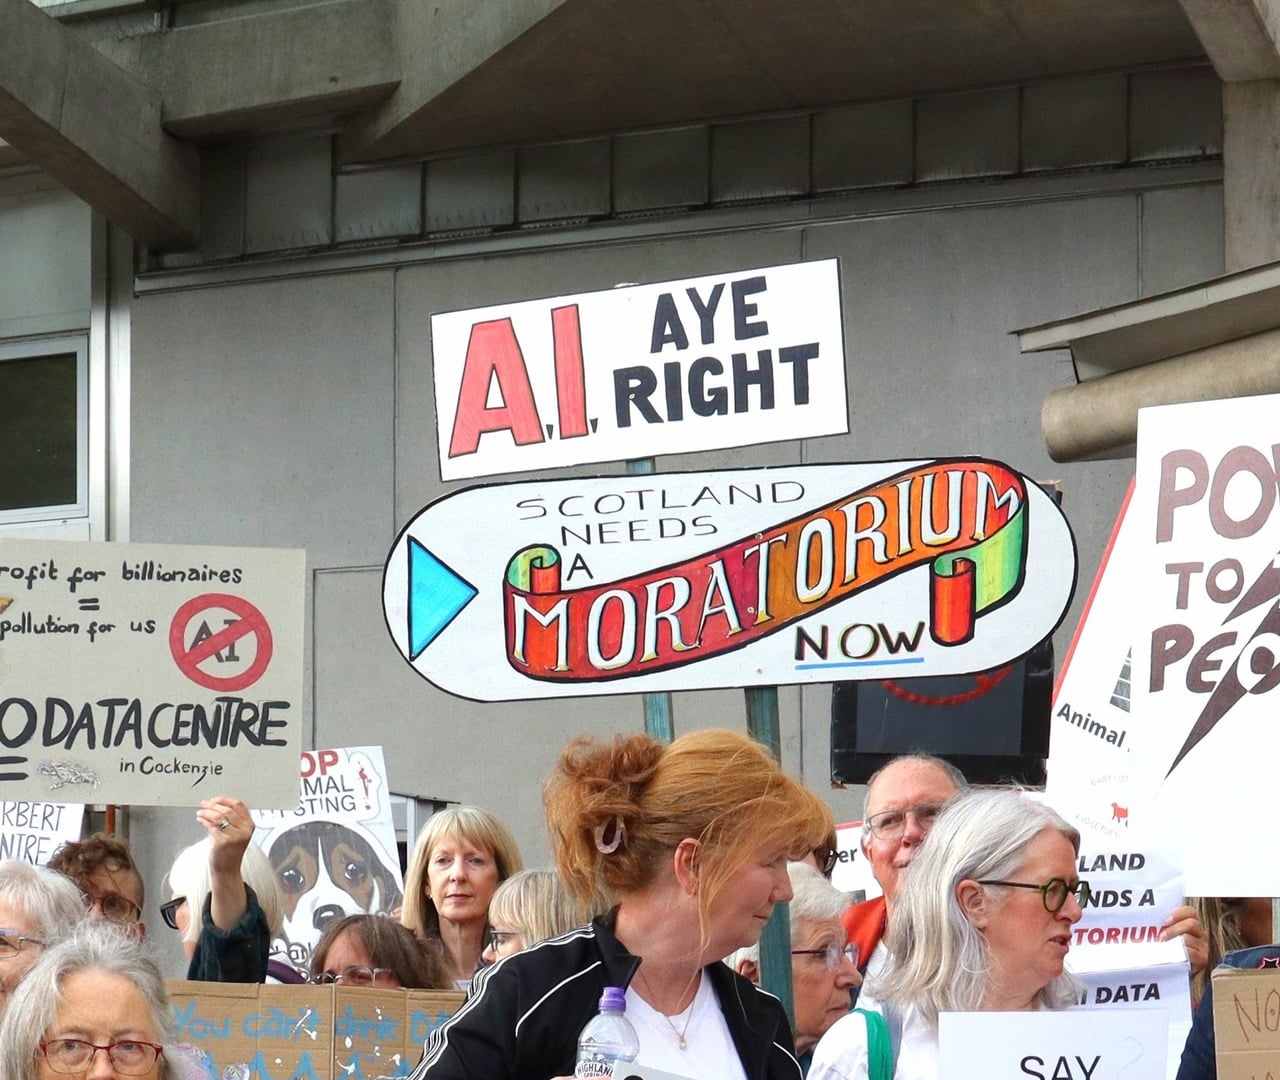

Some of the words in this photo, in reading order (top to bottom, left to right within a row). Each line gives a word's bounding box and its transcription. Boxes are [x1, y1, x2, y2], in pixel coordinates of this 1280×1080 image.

[448, 304, 598, 458] A.I.
[650, 277, 767, 353] AYE
[613, 343, 820, 428] RIGHT
[516, 481, 805, 521] SCOTLAND
[562, 515, 718, 547] NEEDS
[67, 567, 106, 593] for
[121, 560, 243, 584] billionaires
[512, 470, 1020, 671] MORATORIUM
[567, 553, 593, 581] A
[1166, 558, 1245, 609] TO
[0, 611, 79, 641] pollution
[86, 620, 116, 643] for
[130, 619, 156, 634] us
[188, 619, 240, 663] AI
[796, 622, 925, 661] NOW
[41, 696, 143, 750] DATA
[147, 696, 290, 750] CENTRE
[1057, 703, 1126, 748] Animal
[119, 757, 135, 773] in
[139, 756, 223, 787] Cockenzie
[1138, 889, 1156, 907] A
[1095, 983, 1161, 1005] DATA
[170, 1001, 232, 1040] You
